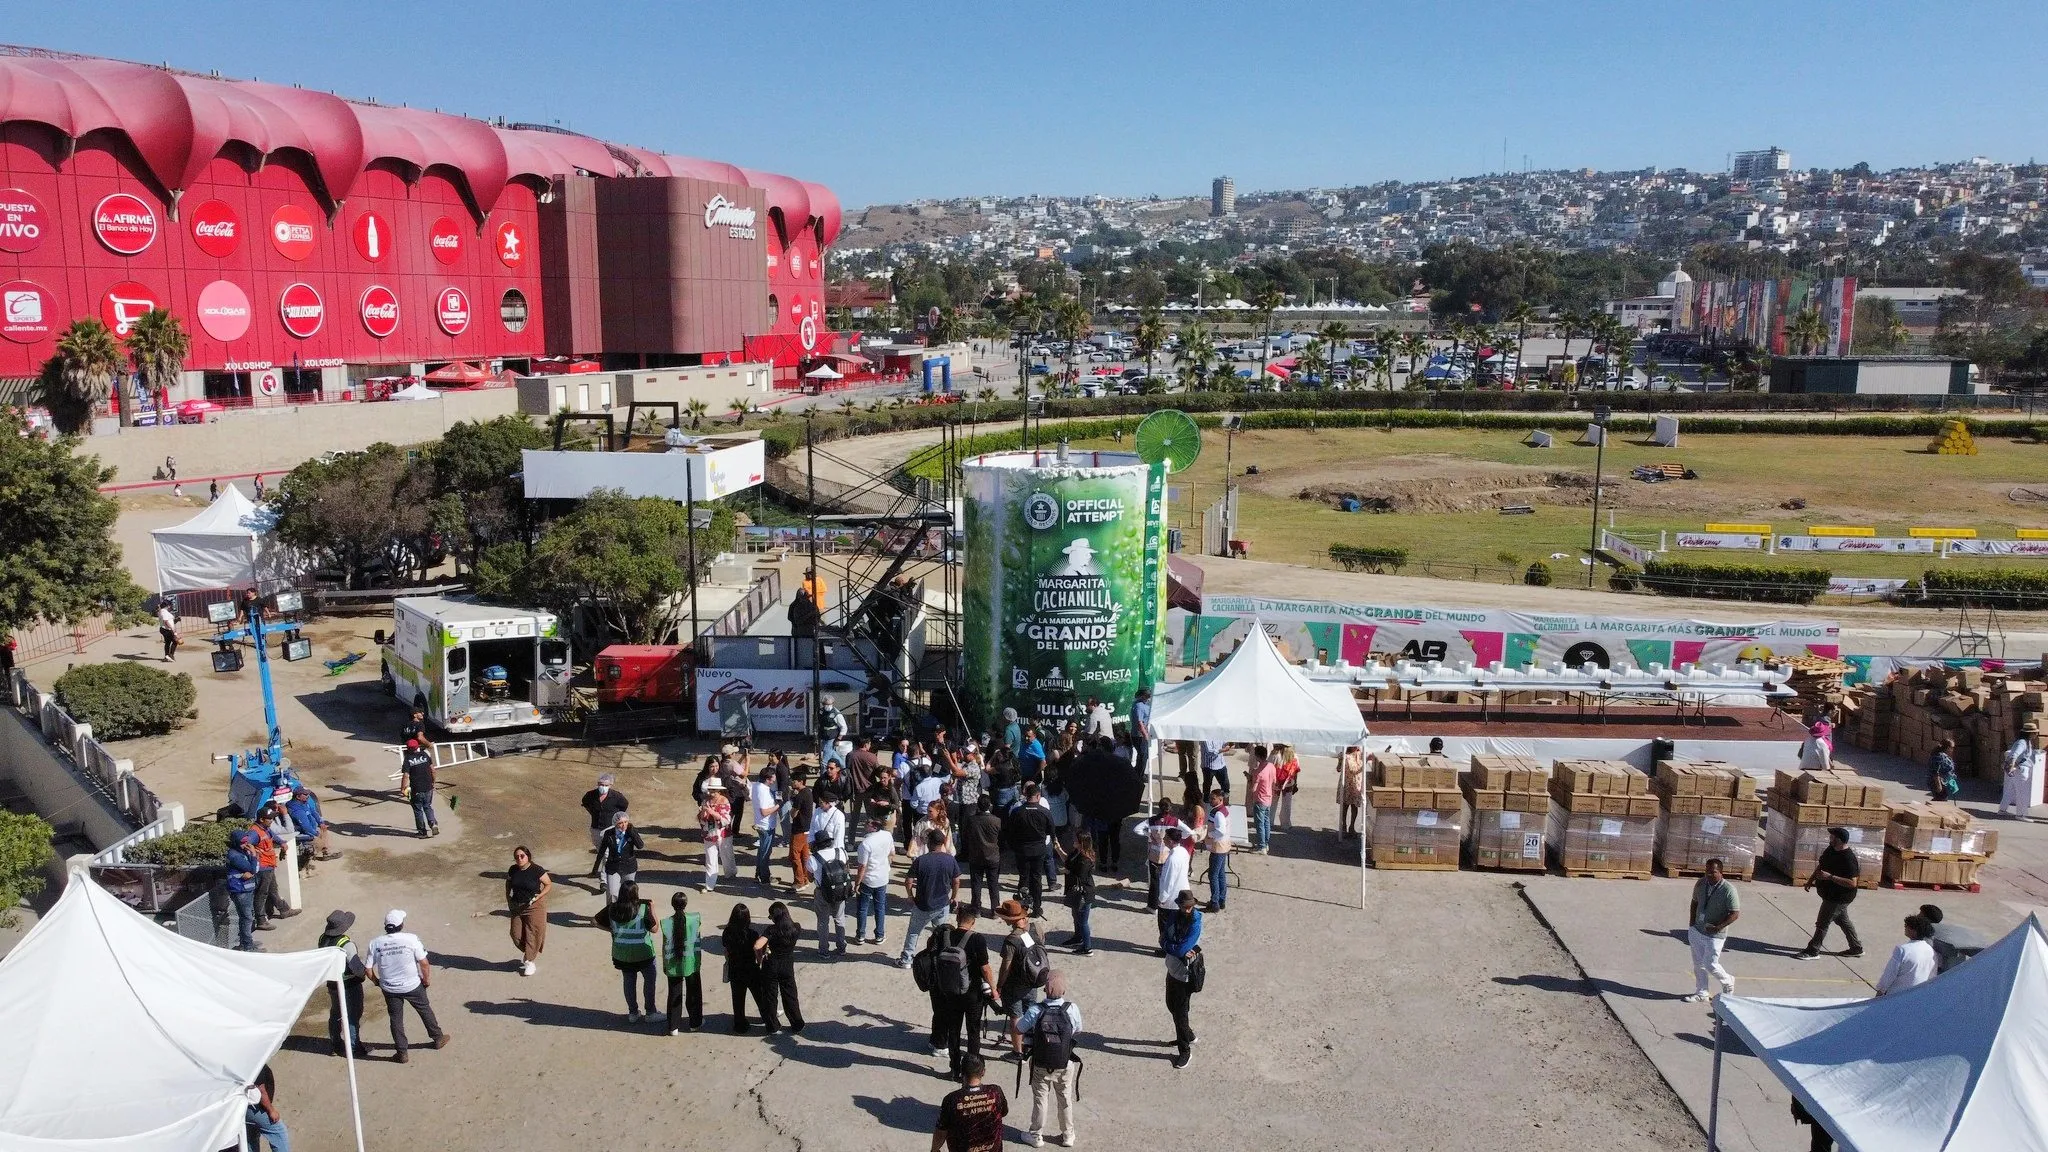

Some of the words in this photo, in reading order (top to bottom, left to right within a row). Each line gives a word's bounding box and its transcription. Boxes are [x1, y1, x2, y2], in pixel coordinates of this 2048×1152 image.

[7, 213, 22, 221] EN
[113, 214, 153, 225] AFIRME
[140, 225, 153, 234] Hoy
[729, 227, 757, 239] ESTADIO
[224, 361, 273, 370] XOLOSHOP
[304, 358, 344, 367] XOLOSHOP
[1066, 498, 1125, 511] OFFICIAL
[1066, 510, 1125, 523] ATTEMPT
[1038, 578, 1106, 589] MARGARITA
[1034, 589, 1112, 612] CACHANILLA
[1211, 604, 1256, 612] CACHANILLA
[1275, 603, 1337, 614] MARGARITA
[1364, 608, 1423, 620] GRANDE
[1425, 611, 1443, 620] DEL
[1446, 613, 1486, 622] MUNDO
[1093, 615, 1108, 623] MÁS
[1027, 624, 1117, 640] GRANDE
[1533, 623, 1580, 631] CACHANILLA
[1584, 622, 1598, 630] LA
[1600, 622, 1664, 633] MARGARITA
[1694, 626, 1756, 637] GRANDE
[1757, 626, 1776, 636] DEL
[1779, 627, 1822, 637] MUNDO
[1037, 641, 1059, 650] DEL
[1063, 640, 1107, 650] MUNDO
[697, 669, 732, 678] Nuevo
[1086, 668, 1132, 681] REVISTA
[1036, 679, 1074, 690] CACHANILLA
